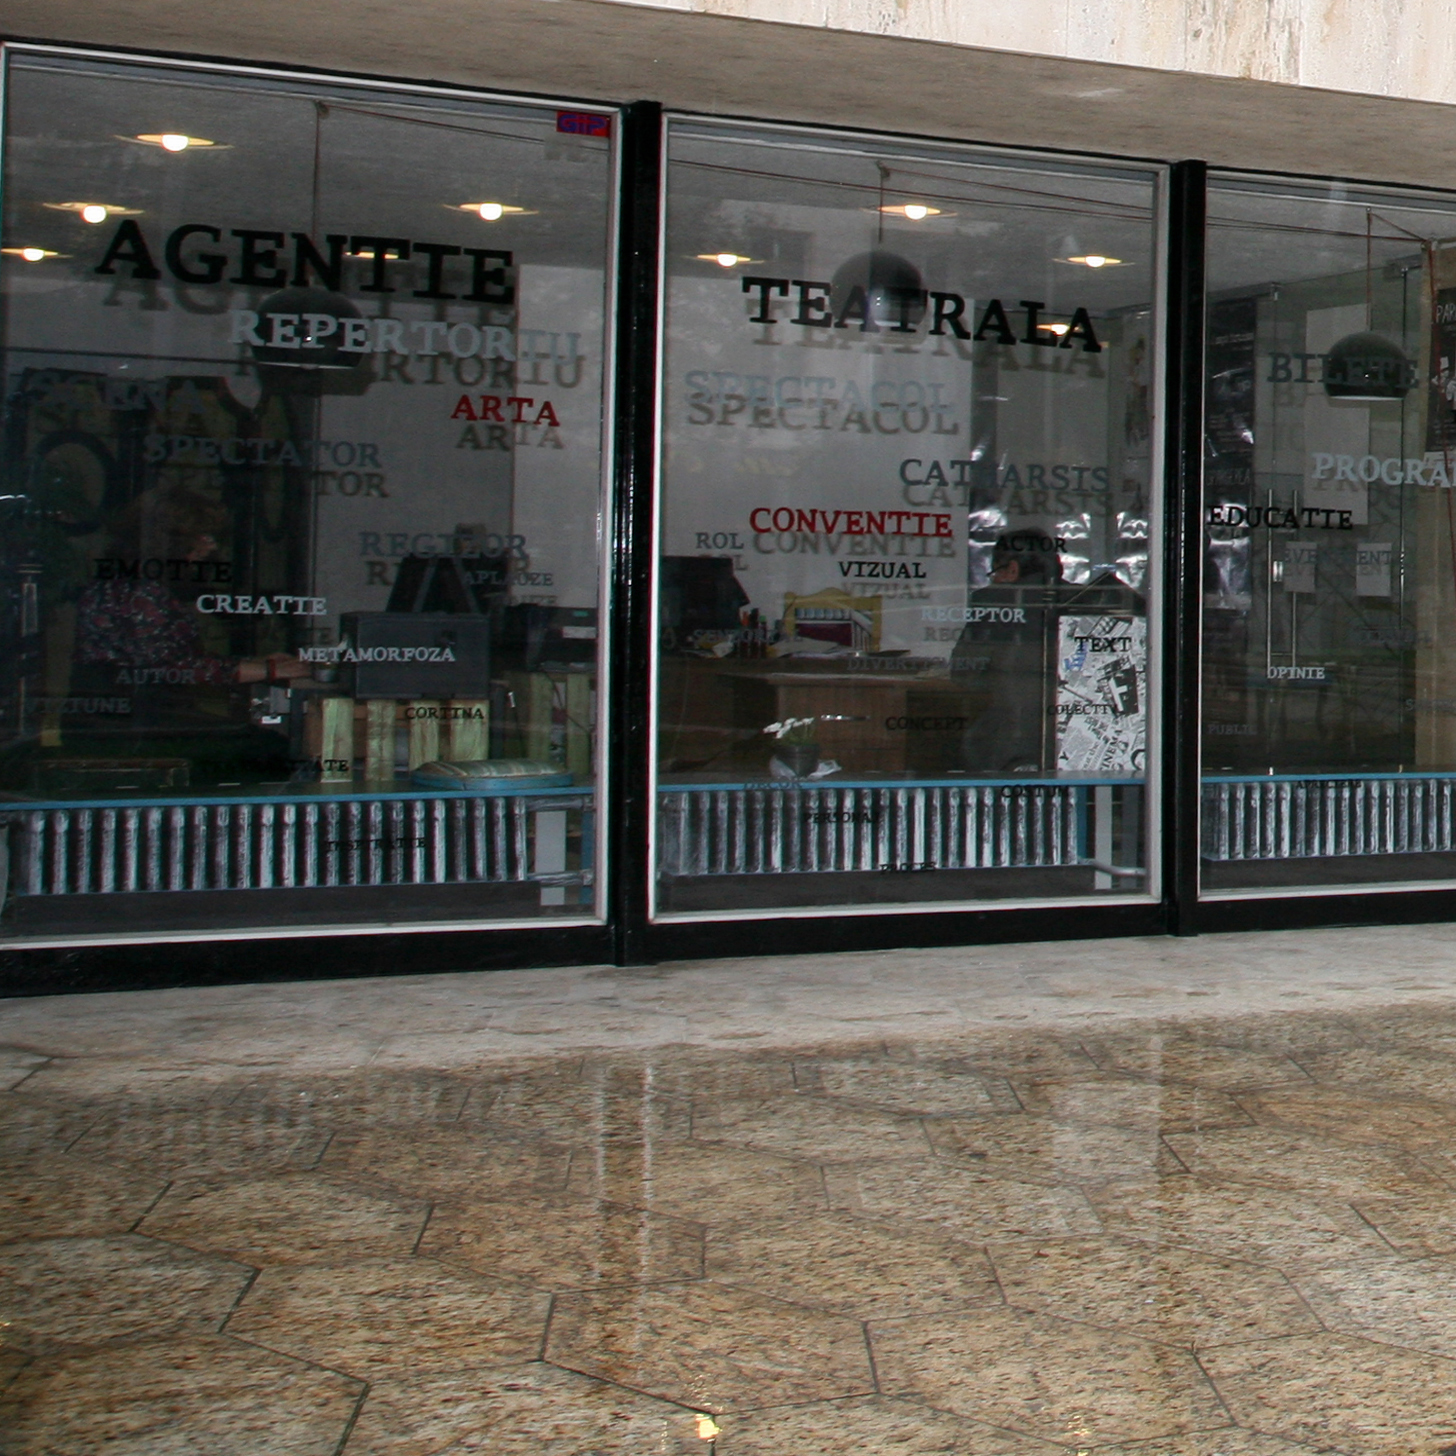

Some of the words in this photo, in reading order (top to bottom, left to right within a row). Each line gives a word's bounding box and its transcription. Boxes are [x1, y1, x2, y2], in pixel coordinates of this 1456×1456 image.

[95, 219, 514, 304] AGENTIE
[742, 276, 1101, 352] TEATRALA
[231, 309, 581, 362] REPERTORIU
[1267, 352, 1420, 390] BILETE
[685, 369, 950, 414] SPECTACOL
[451, 395, 560, 427] ARTA
[143, 433, 382, 468] SPECTATOR
[750, 507, 953, 538] CONVENTIE
[1206, 506, 1353, 530] EDUCATIE
[695, 532, 745, 551] ROL
[998, 535, 1068, 554] ACTOR
[93, 558, 233, 584] EMOTIE
[839, 560, 927, 580] VIZUAL
[196, 594, 327, 616] CREATIE
[921, 607, 1026, 624] RECEPTOR
[298, 646, 456, 663] METAMORFOZA
[1074, 636, 1132, 653] TEXT
[115, 668, 197, 686] AUTOR
[1267, 666, 1326, 680] OPINIE
[405, 707, 485, 720] CORTINA
[885, 716, 968, 732] CONCEPT
